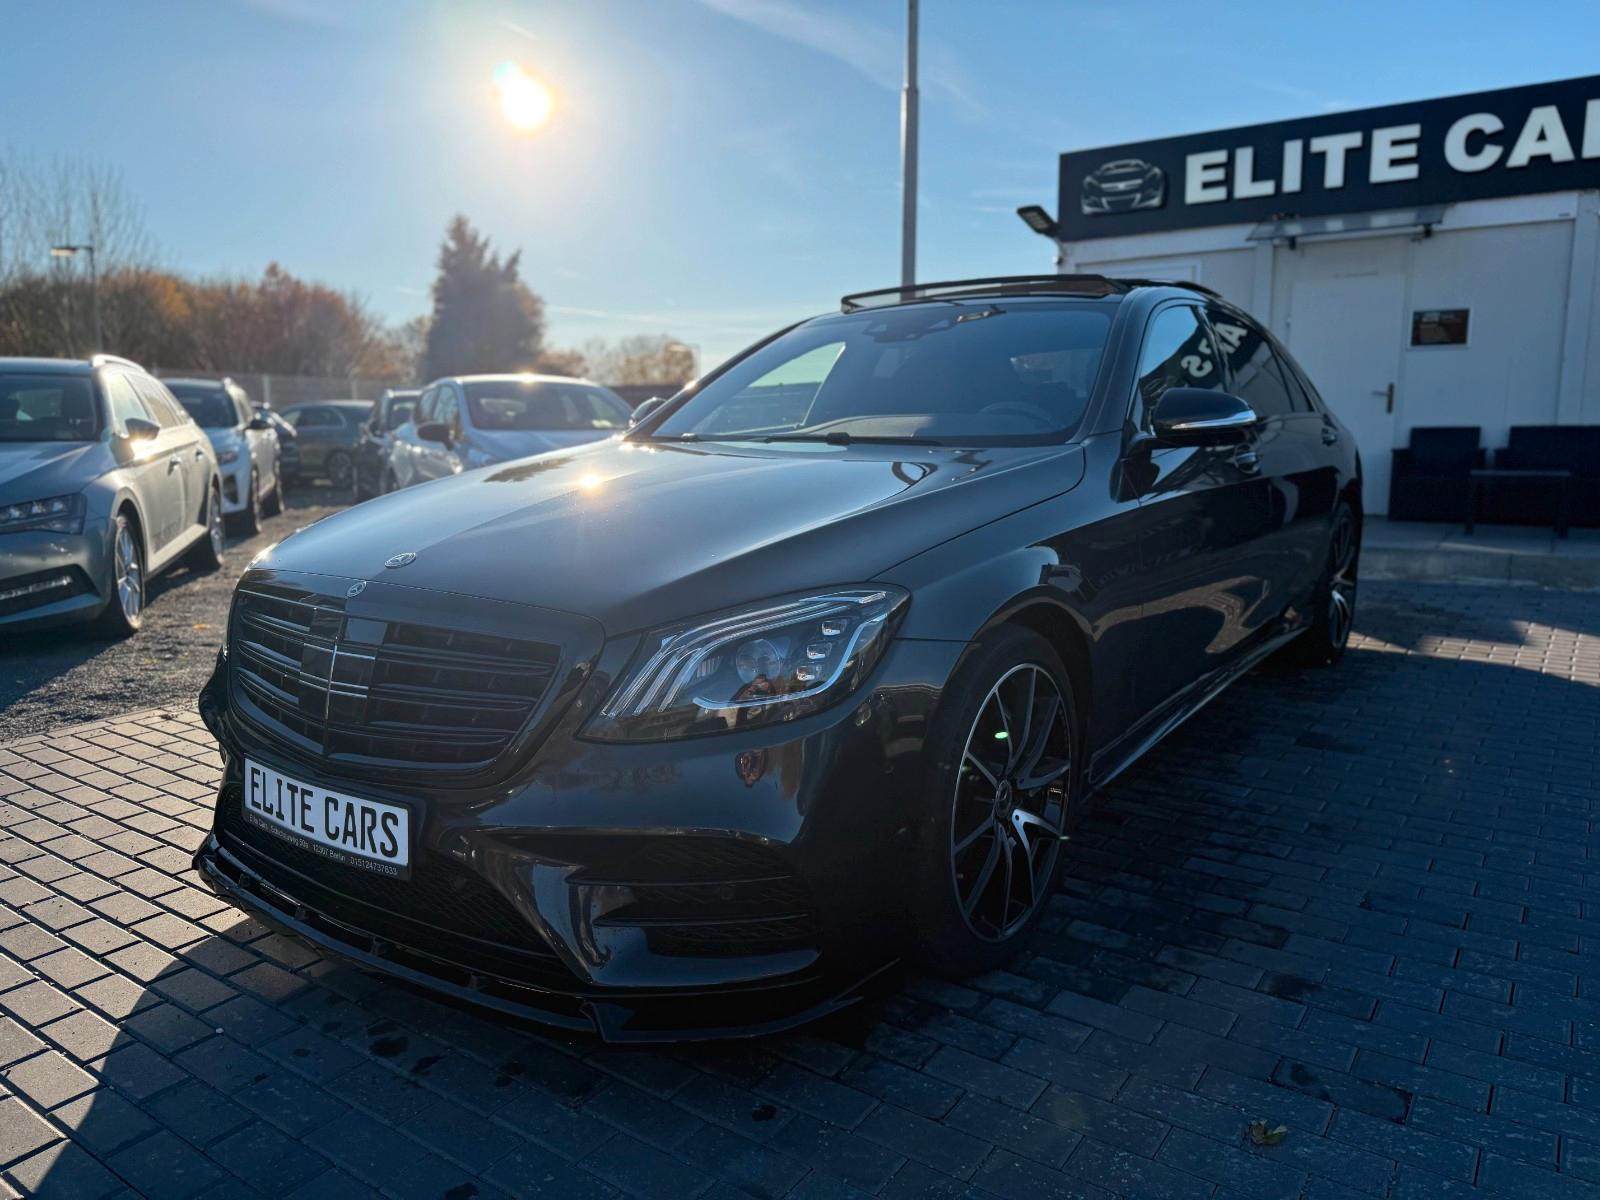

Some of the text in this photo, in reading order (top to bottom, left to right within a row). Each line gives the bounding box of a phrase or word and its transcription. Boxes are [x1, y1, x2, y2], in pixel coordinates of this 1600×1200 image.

[1185, 123, 1422, 205] ELITE
[250, 766, 399, 858] ELITE CARS
